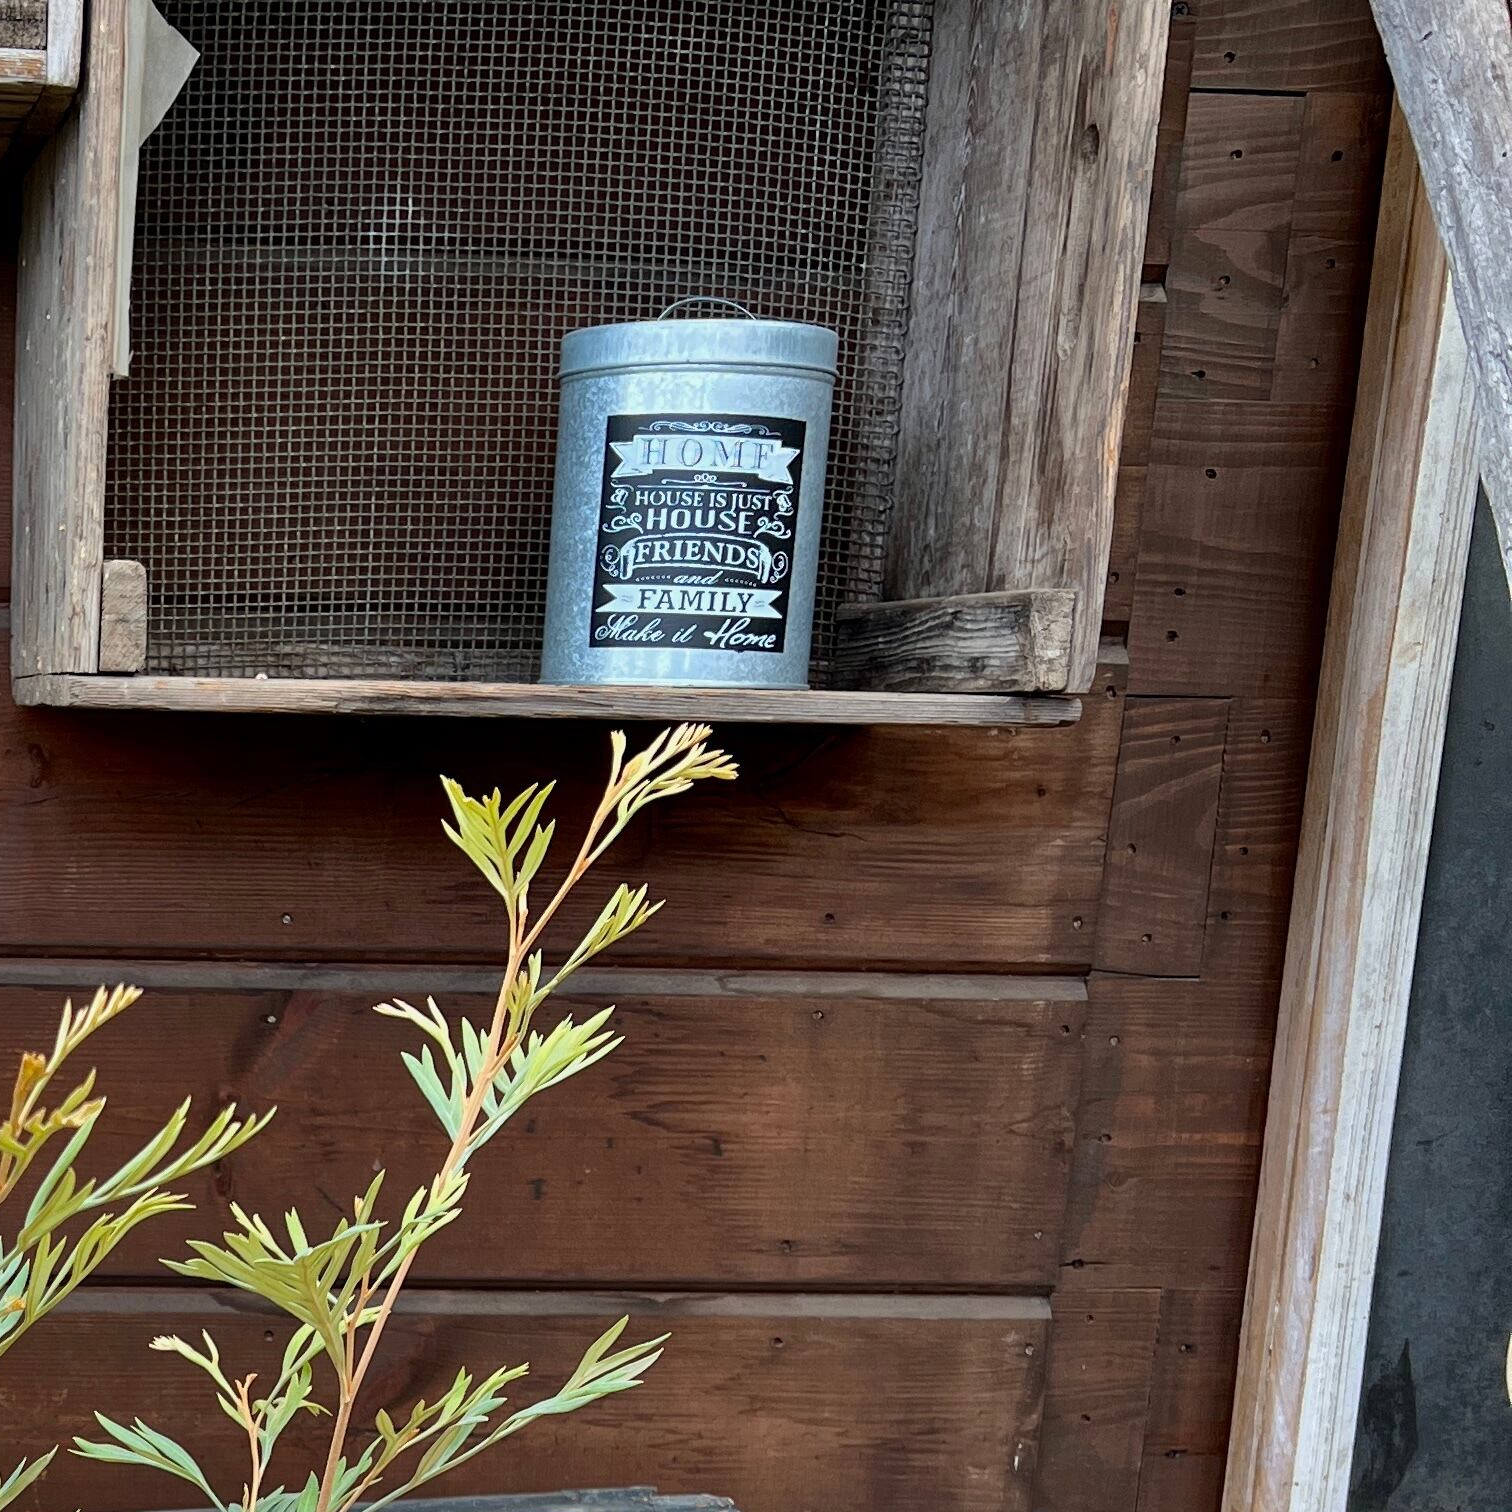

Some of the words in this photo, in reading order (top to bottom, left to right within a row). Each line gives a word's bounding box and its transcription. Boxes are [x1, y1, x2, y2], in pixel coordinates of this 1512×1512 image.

[635, 490, 704, 509] HOUSE
[709, 491, 727, 509] IS
[729, 492, 774, 513] JUST
[645, 508, 756, 536] HOUSE
[634, 539, 760, 570] FRIENDS
[673, 570, 723, 586] and
[636, 587, 755, 615] FAMILY
[594, 614, 665, 643] Make
[672, 623, 697, 643] it
[703, 617, 776, 649] Home
